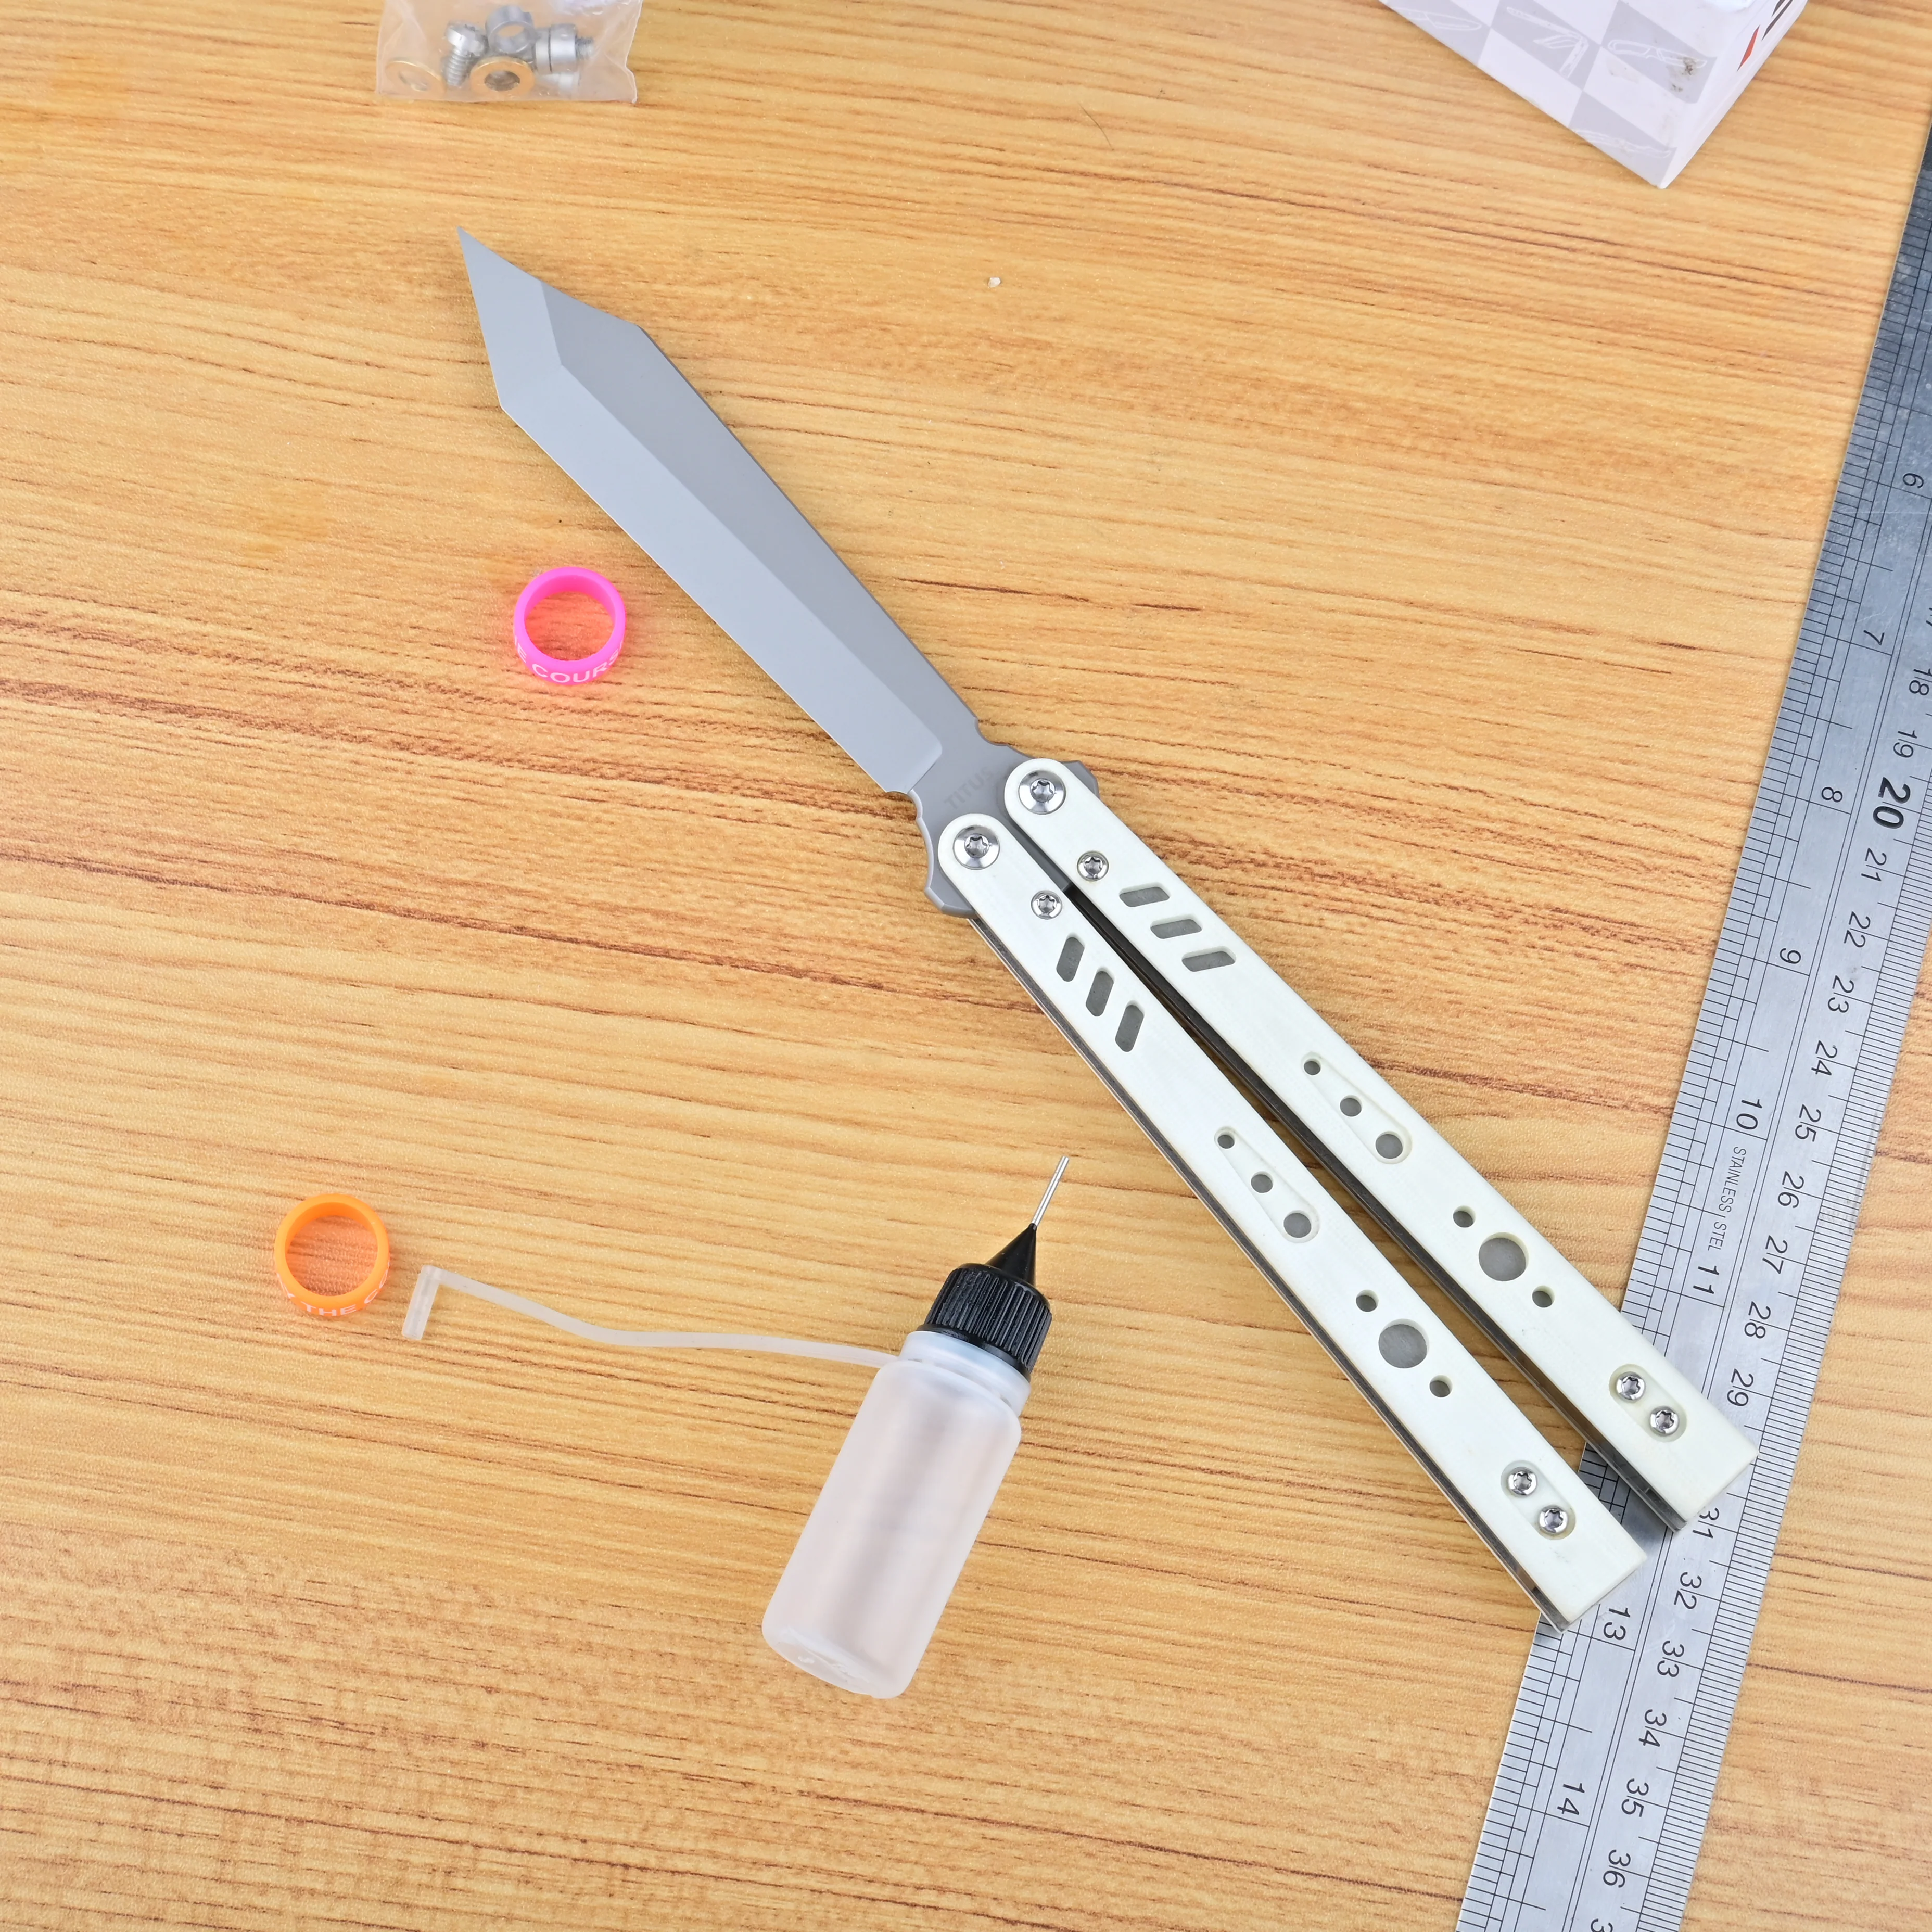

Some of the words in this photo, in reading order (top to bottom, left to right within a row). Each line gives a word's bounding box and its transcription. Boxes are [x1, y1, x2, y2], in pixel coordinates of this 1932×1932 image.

[1902, 473, 1924, 489] 6
[1863, 630, 1885, 646] 7
[532, 640, 623, 683] COURS
[1909, 668, 1932, 696] 18
[1893, 730, 1917, 758] 19
[944, 767, 994, 810] TITUS
[1821, 786, 1843, 803] 8
[1873, 777, 1911, 829] 20
[1861, 848, 1887, 881] 21
[1844, 911, 1871, 948] 22
[1780, 948, 1801, 964] 9
[1827, 975, 1854, 1013] 23
[1811, 1040, 1838, 1076] 24
[1736, 1099, 1762, 1130] 10
[1795, 1104, 1821, 1142] 25
[1718, 1147, 1747, 1213] STAINLESS
[1778, 1171, 1804, 1208] 26
[1708, 1222, 1727, 1251] STEL
[1762, 1235, 1788, 1274] 27
[1693, 1265, 1719, 1294] 11
[301, 1301, 357, 1316] THE
[1744, 1301, 1771, 1339] 28
[1727, 1368, 1753, 1407] 29
[1692, 1508, 1720, 1539] 31
[1674, 1572, 1702, 1609] 32
[1603, 1608, 1631, 1640] 13
[1657, 1641, 1684, 1677] 33
[1638, 1709, 1667, 1747] 34
[1557, 1783, 1585, 1815] 14
[1621, 1778, 1649, 1817] 35
[1603, 1849, 1631, 1888] 36
